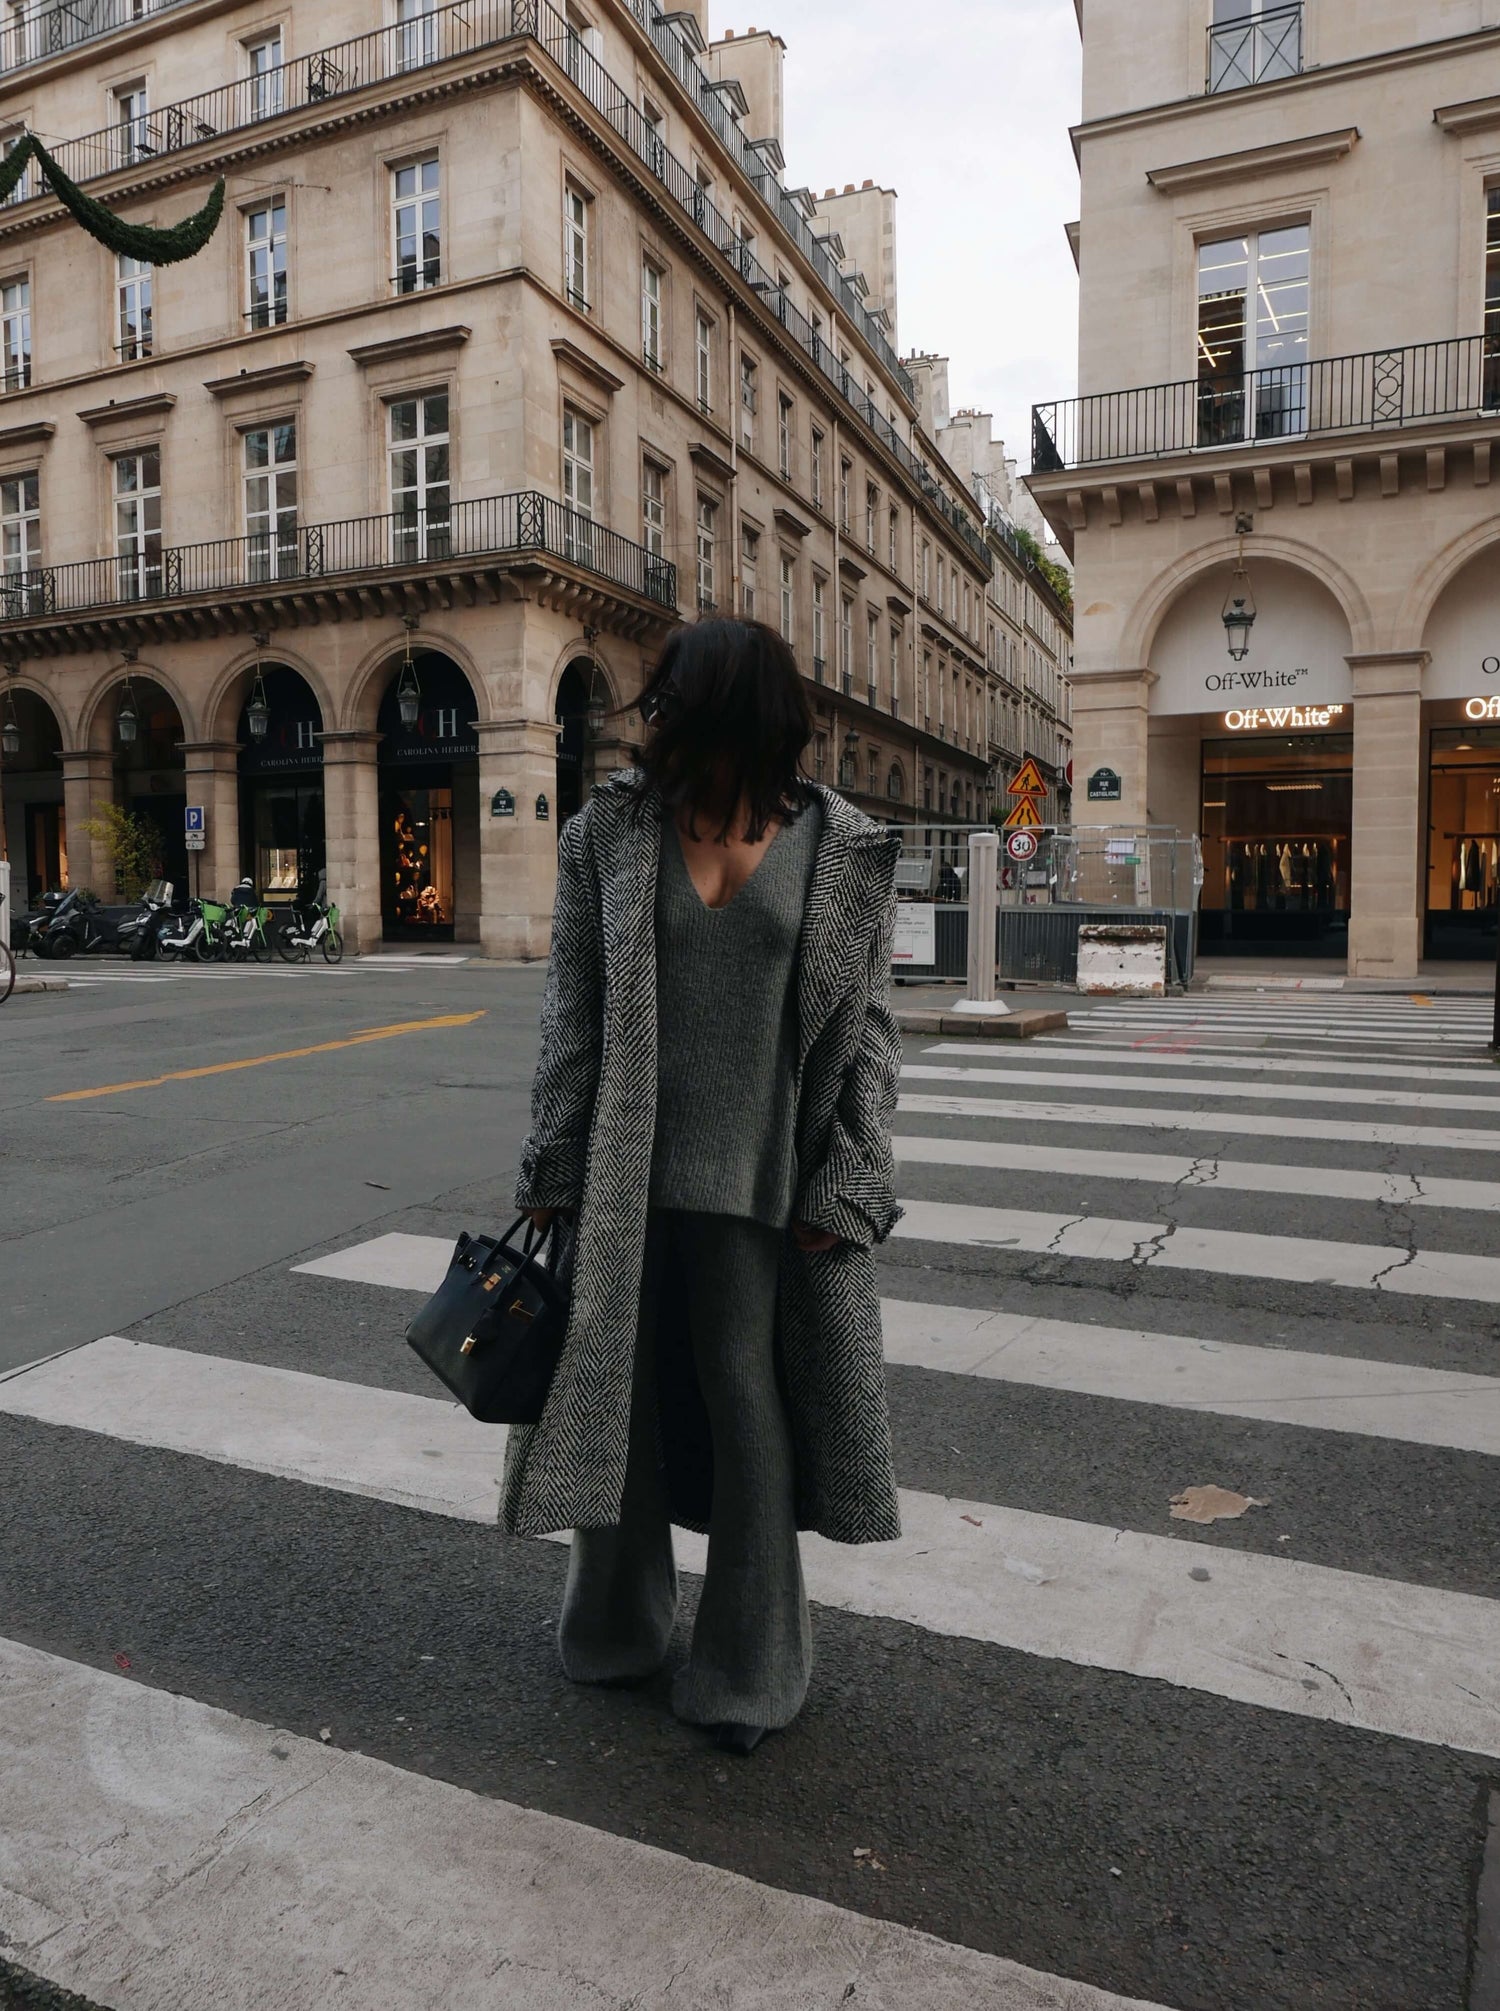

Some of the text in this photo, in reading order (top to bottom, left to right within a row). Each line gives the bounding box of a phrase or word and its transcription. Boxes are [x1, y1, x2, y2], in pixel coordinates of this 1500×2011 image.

[396, 744, 477, 757] CAROLINA HERRER
[260, 758, 298, 768] CAROLINA
[189, 811, 198, 827] P
[1013, 839, 1030, 852] 30
